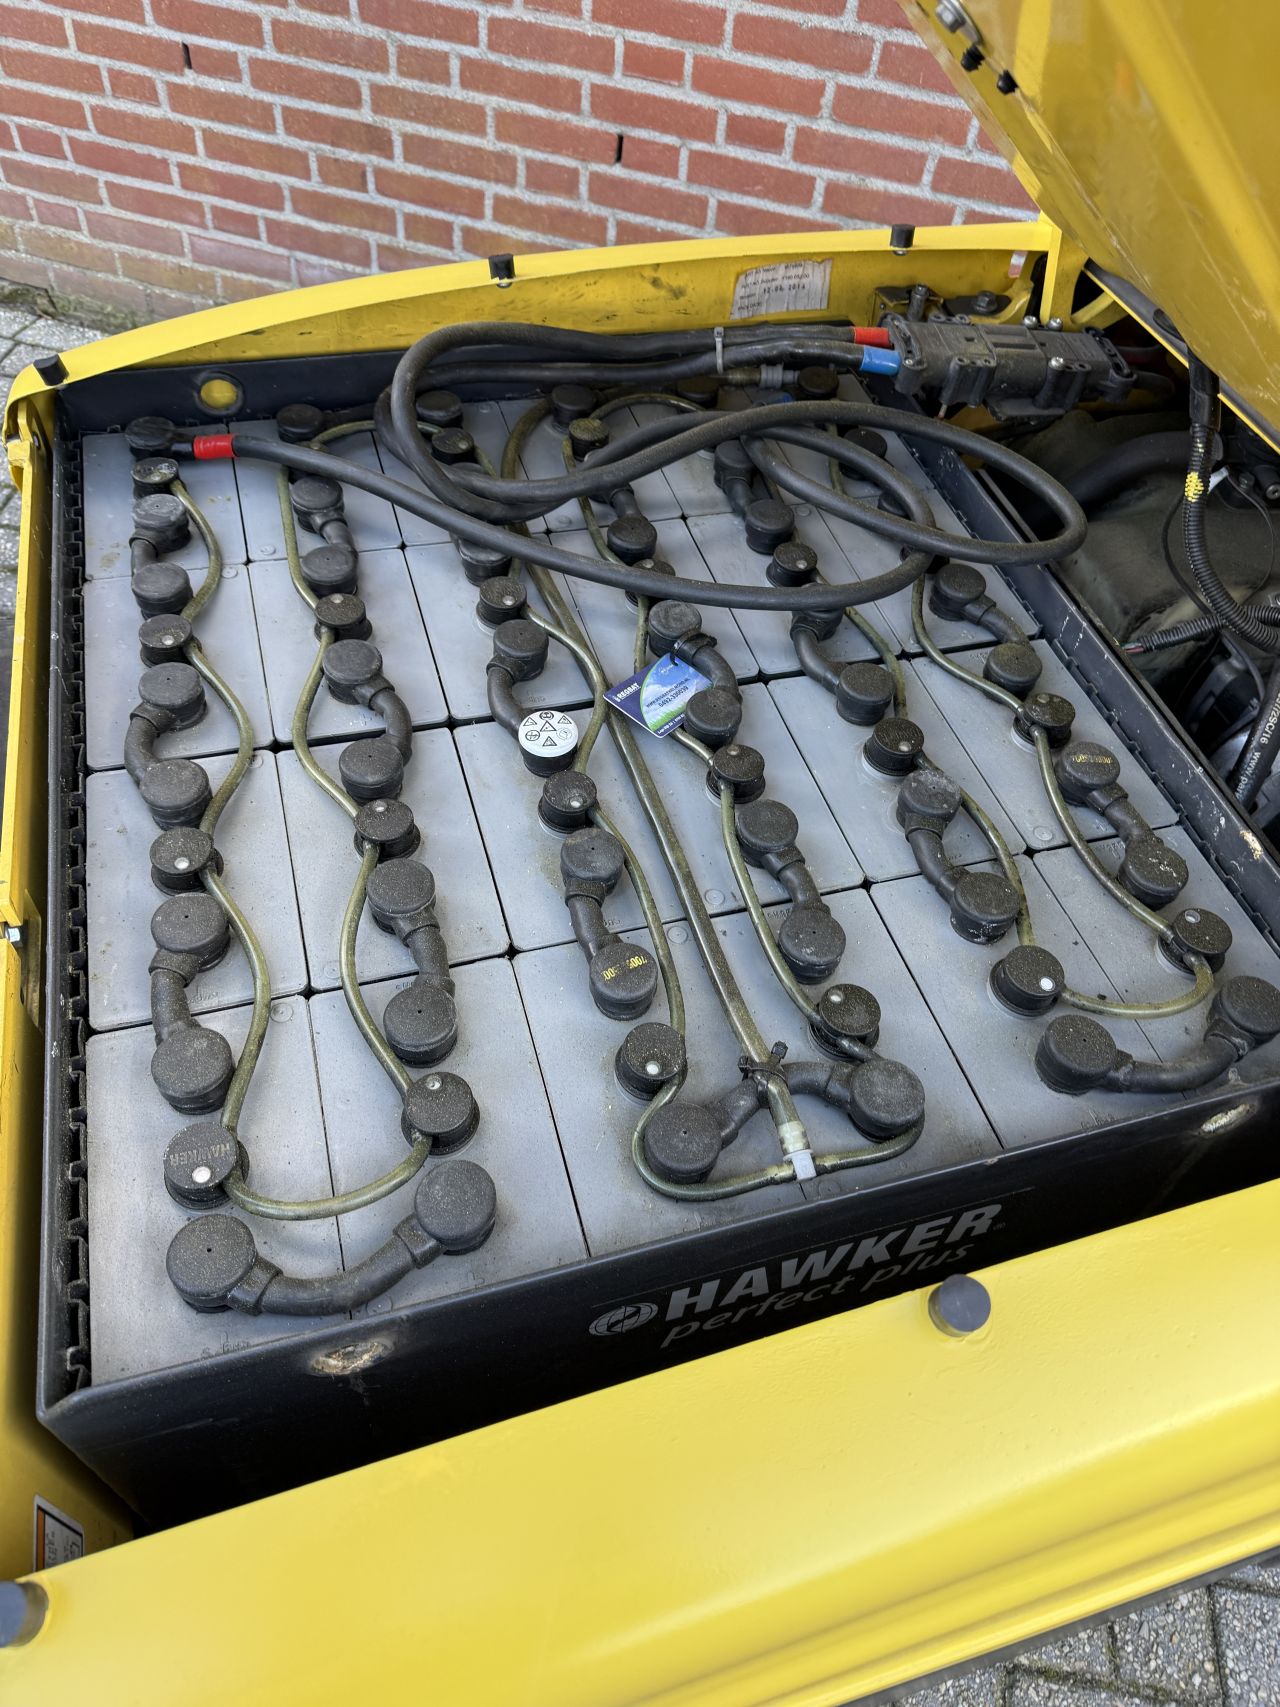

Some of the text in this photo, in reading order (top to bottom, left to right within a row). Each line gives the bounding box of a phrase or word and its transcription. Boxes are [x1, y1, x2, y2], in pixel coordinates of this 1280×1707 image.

[660, 1244, 976, 1349] perfect plus
[666, 1204, 1002, 1322] HAWKER
